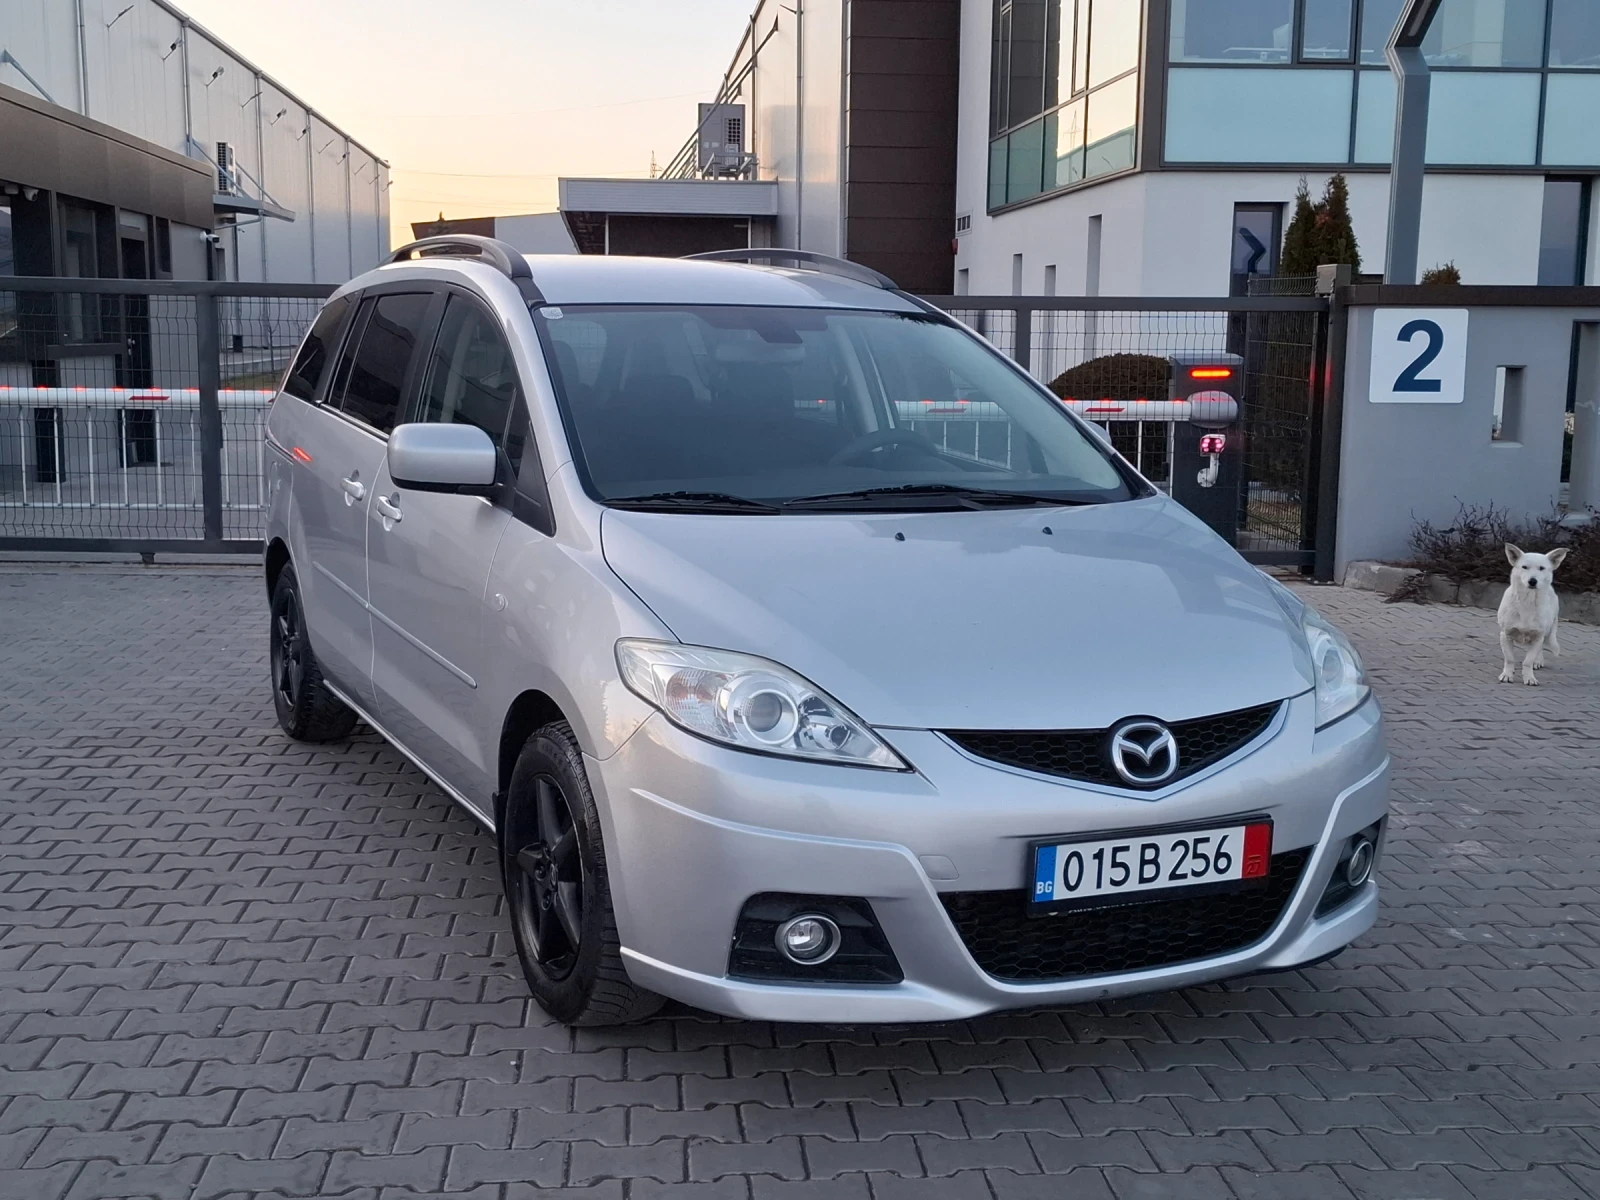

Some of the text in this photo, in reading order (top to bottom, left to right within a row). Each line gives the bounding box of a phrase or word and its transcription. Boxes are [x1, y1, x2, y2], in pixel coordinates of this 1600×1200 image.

[1392, 319, 1444, 392] 2
[1036, 881, 1053, 894] BG
[1063, 834, 1233, 892] 015B256
